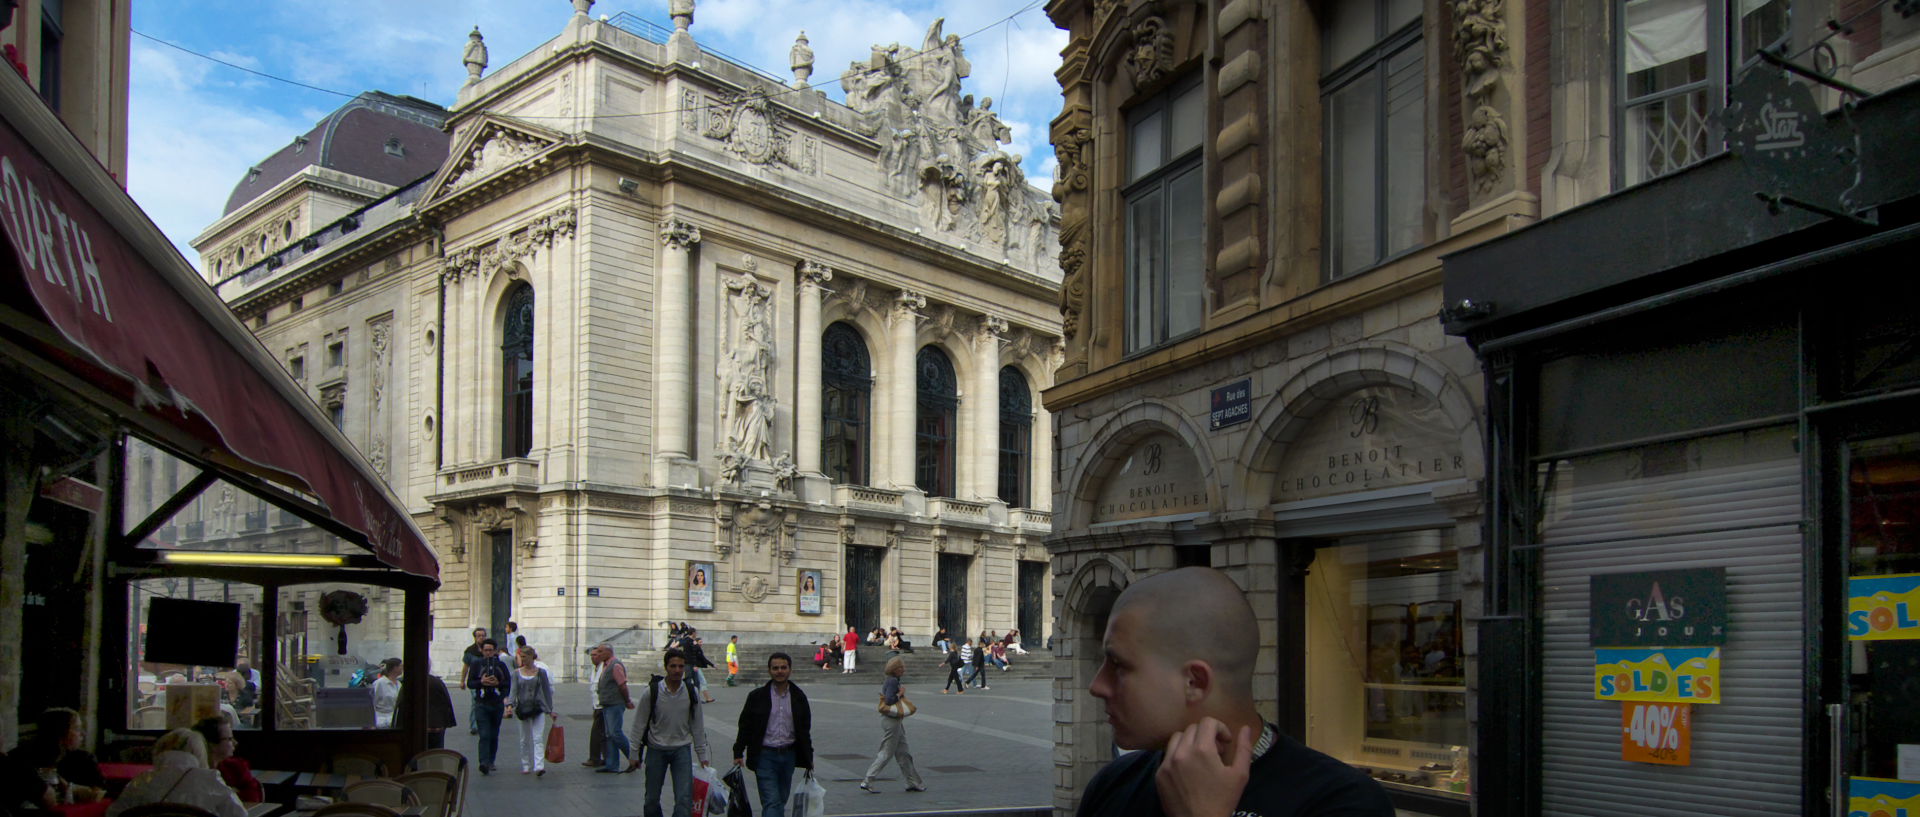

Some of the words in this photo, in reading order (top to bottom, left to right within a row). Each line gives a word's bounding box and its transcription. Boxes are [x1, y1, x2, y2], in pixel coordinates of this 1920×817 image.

[1755, 102, 1805, 150] Star
[0, 155, 113, 323] ORTH
[1226, 391, 1236, 401] Rue
[1236, 389, 1246, 399] des
[1212, 409, 1224, 422] SEPT
[1224, 404, 1248, 418] AGACHES
[1328, 445, 1402, 468] BENOIT
[1281, 456, 1463, 492] CHOCOLATIER
[1130, 483, 1175, 498] BENOIT
[1626, 581, 1684, 621] GAS
[1599, 670, 1712, 698] SOLDES
[1623, 704, 1679, 749] -40%
